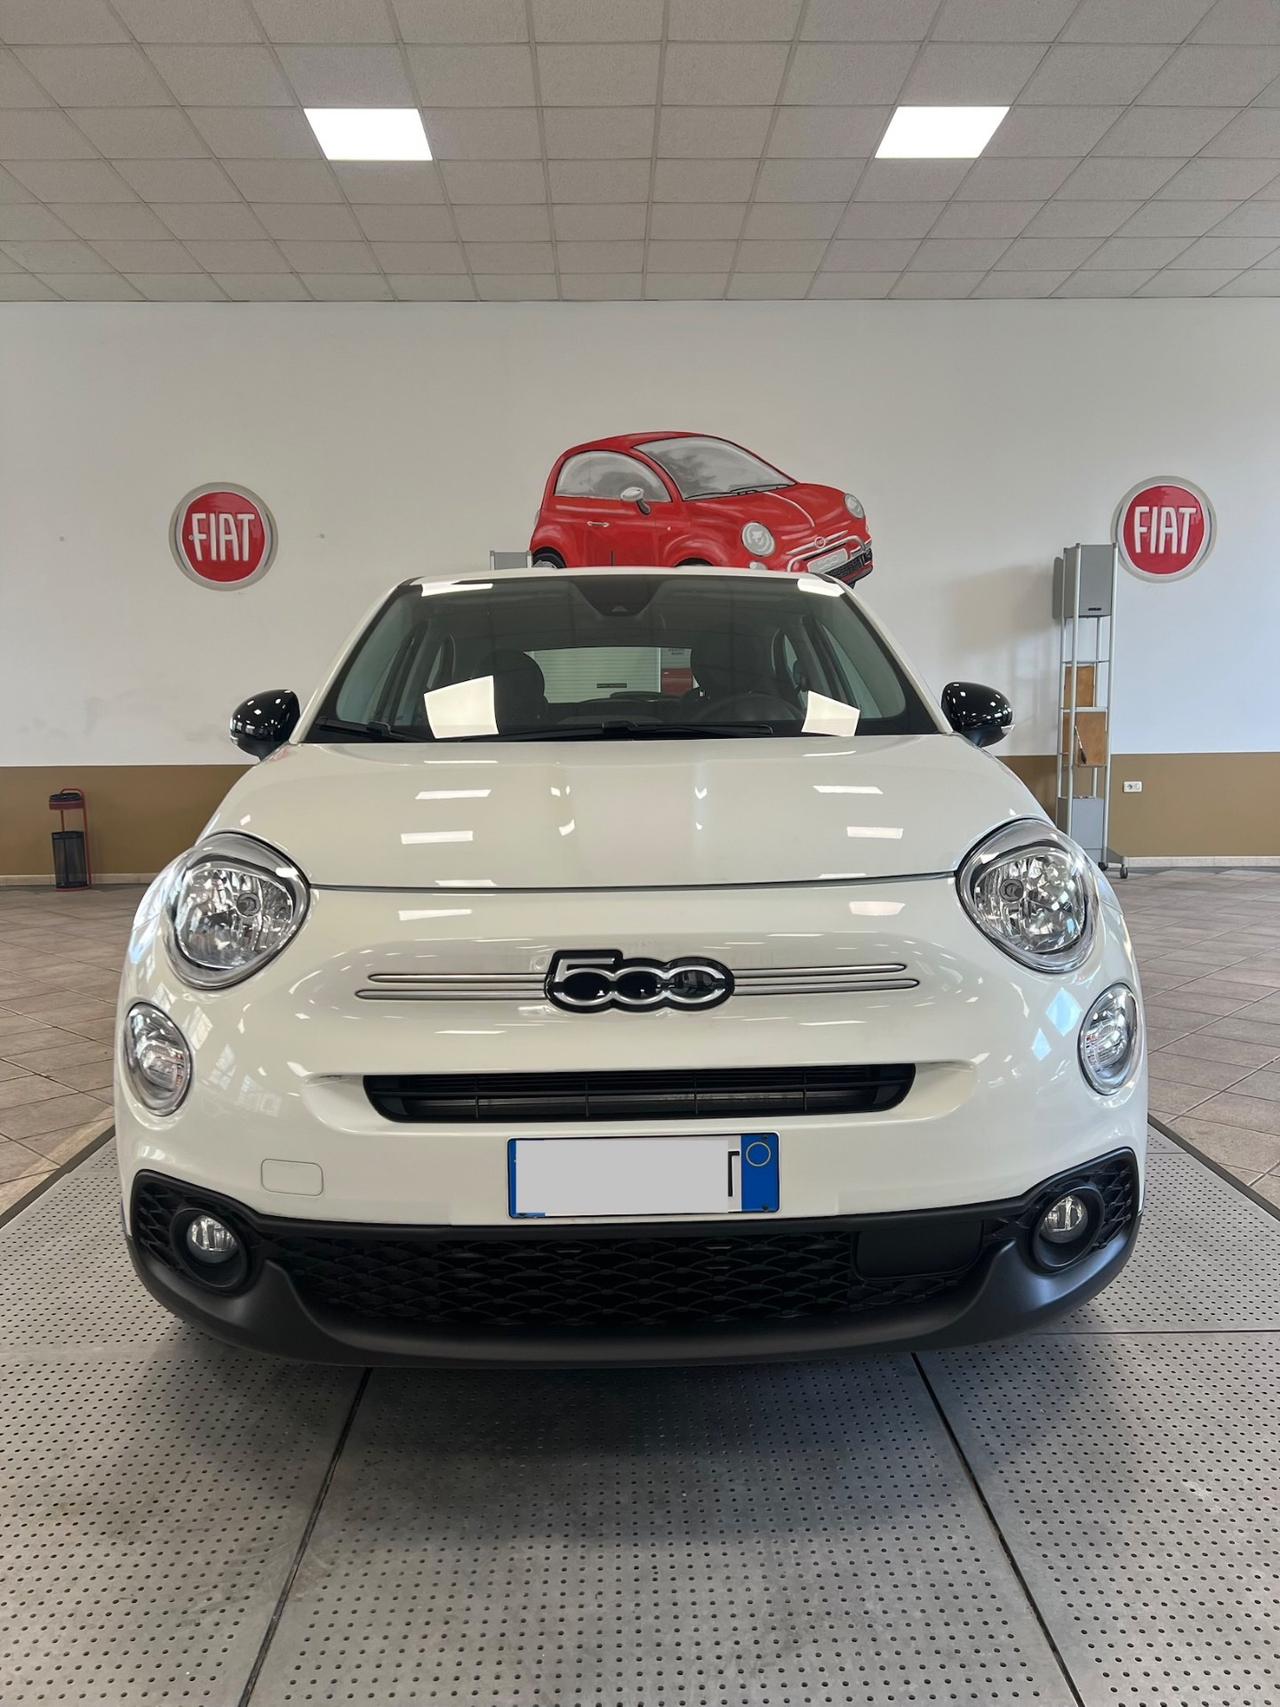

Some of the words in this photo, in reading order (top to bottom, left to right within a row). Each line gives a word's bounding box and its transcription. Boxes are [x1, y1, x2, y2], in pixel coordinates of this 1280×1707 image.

[189, 512, 255, 561] FIAT
[1133, 506, 1197, 554] FIAT
[549, 952, 730, 1009] 500
